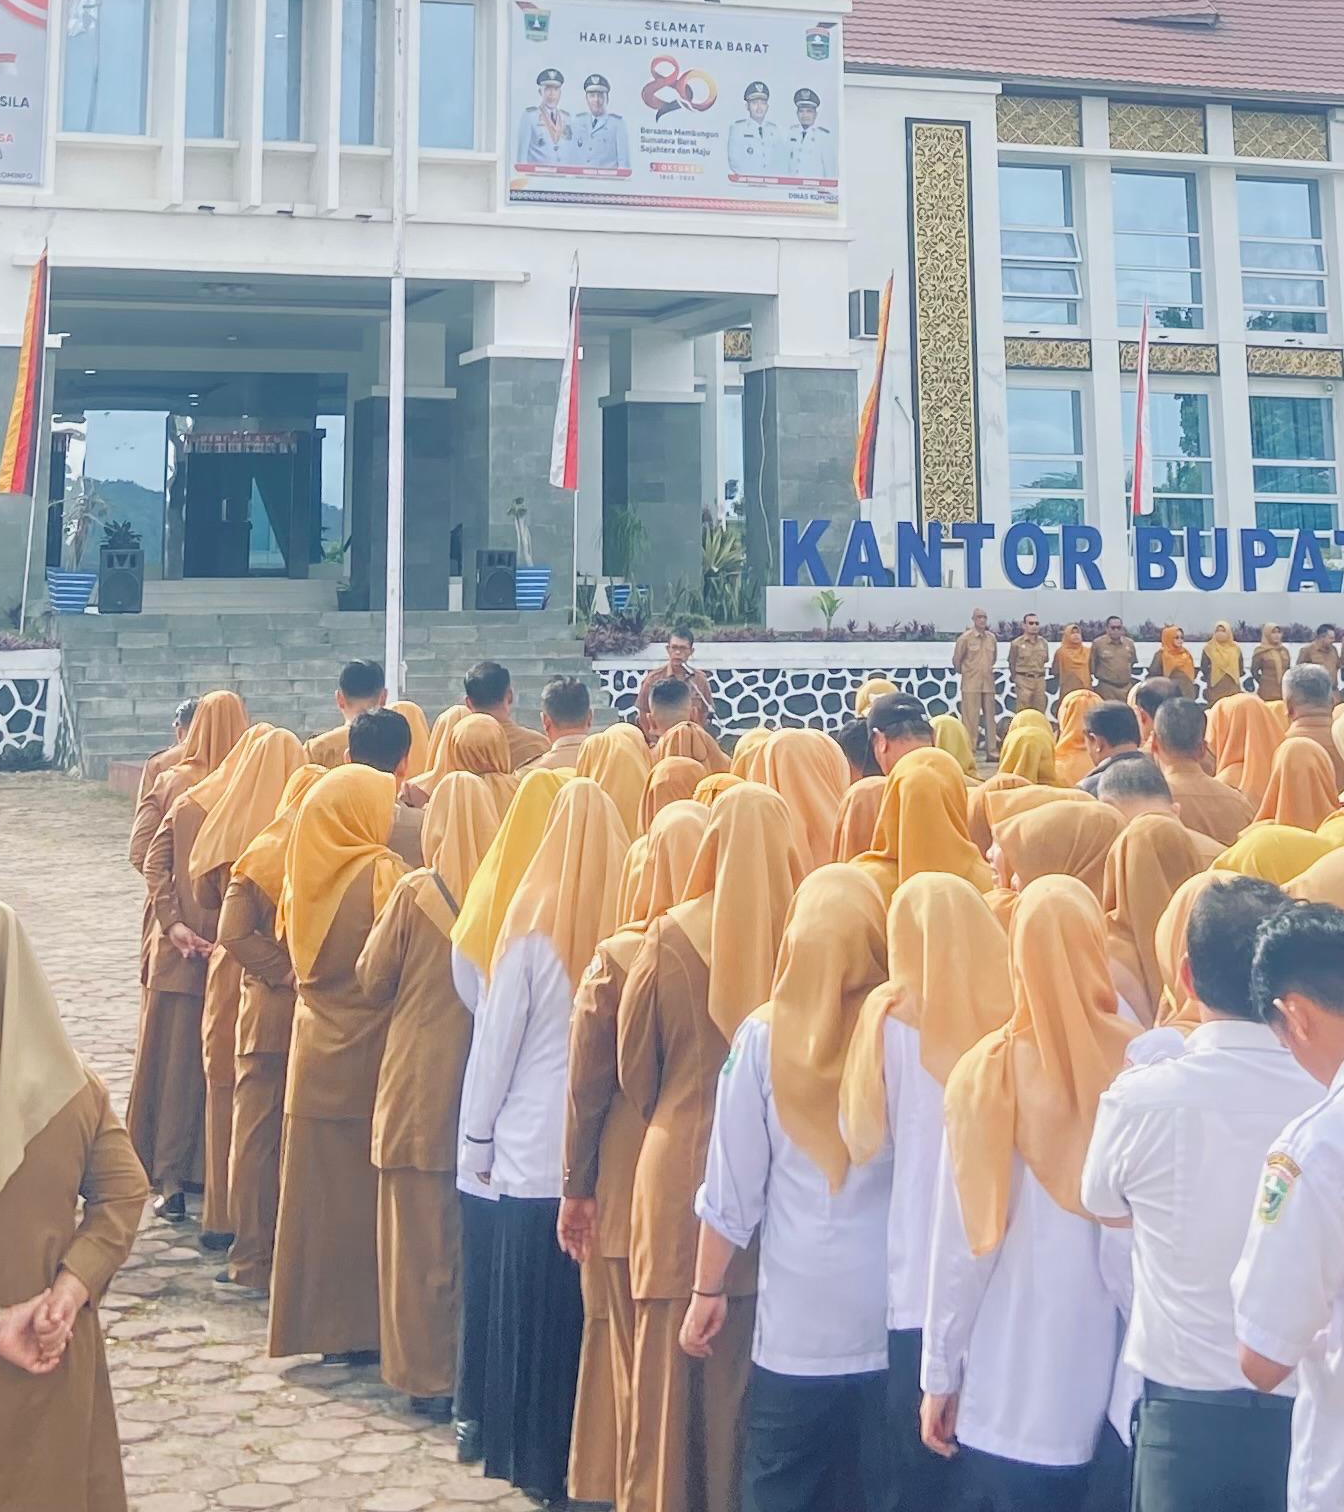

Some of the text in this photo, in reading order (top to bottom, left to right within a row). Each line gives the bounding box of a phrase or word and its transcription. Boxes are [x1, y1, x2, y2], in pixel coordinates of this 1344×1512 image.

[644, 20, 706, 34] SELAMAT
[579, 31, 769, 54] HARI JADI SUMATERA BARAT
[640, 126, 673, 135] Bersama
[780, 518, 1107, 590] KANTOR
